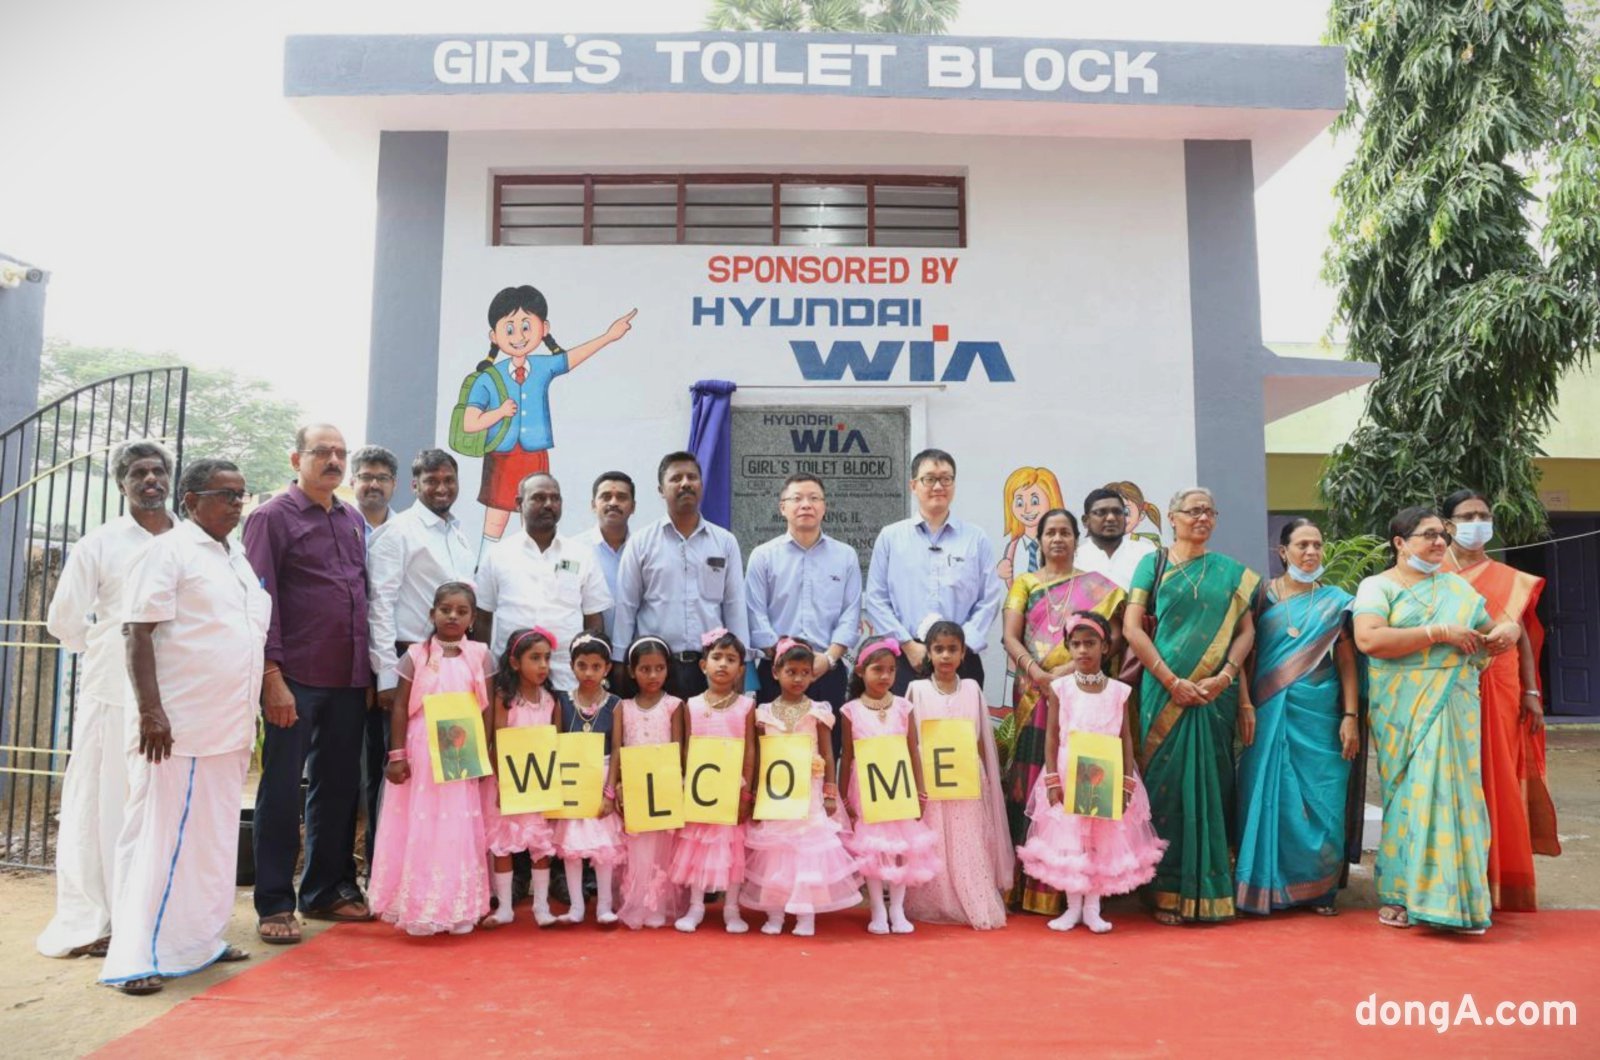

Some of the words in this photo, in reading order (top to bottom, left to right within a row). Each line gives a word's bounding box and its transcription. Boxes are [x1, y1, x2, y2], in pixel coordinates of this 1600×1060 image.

[433, 35, 622, 84] GIRL'S
[655, 41, 897, 87] TOILET
[928, 45, 1158, 94] BLOCK
[708, 255, 910, 284] SPONSORED
[921, 257, 959, 283] BY
[692, 297, 921, 326] HYUNDAI
[789, 325, 1016, 382] WIA
[763, 414, 833, 426] HYUNDAI
[790, 423, 871, 453] WIA
[748, 459, 790, 474] GIRL'S
[796, 460, 838, 475] TOILET
[843, 461, 886, 475] BLOCK
